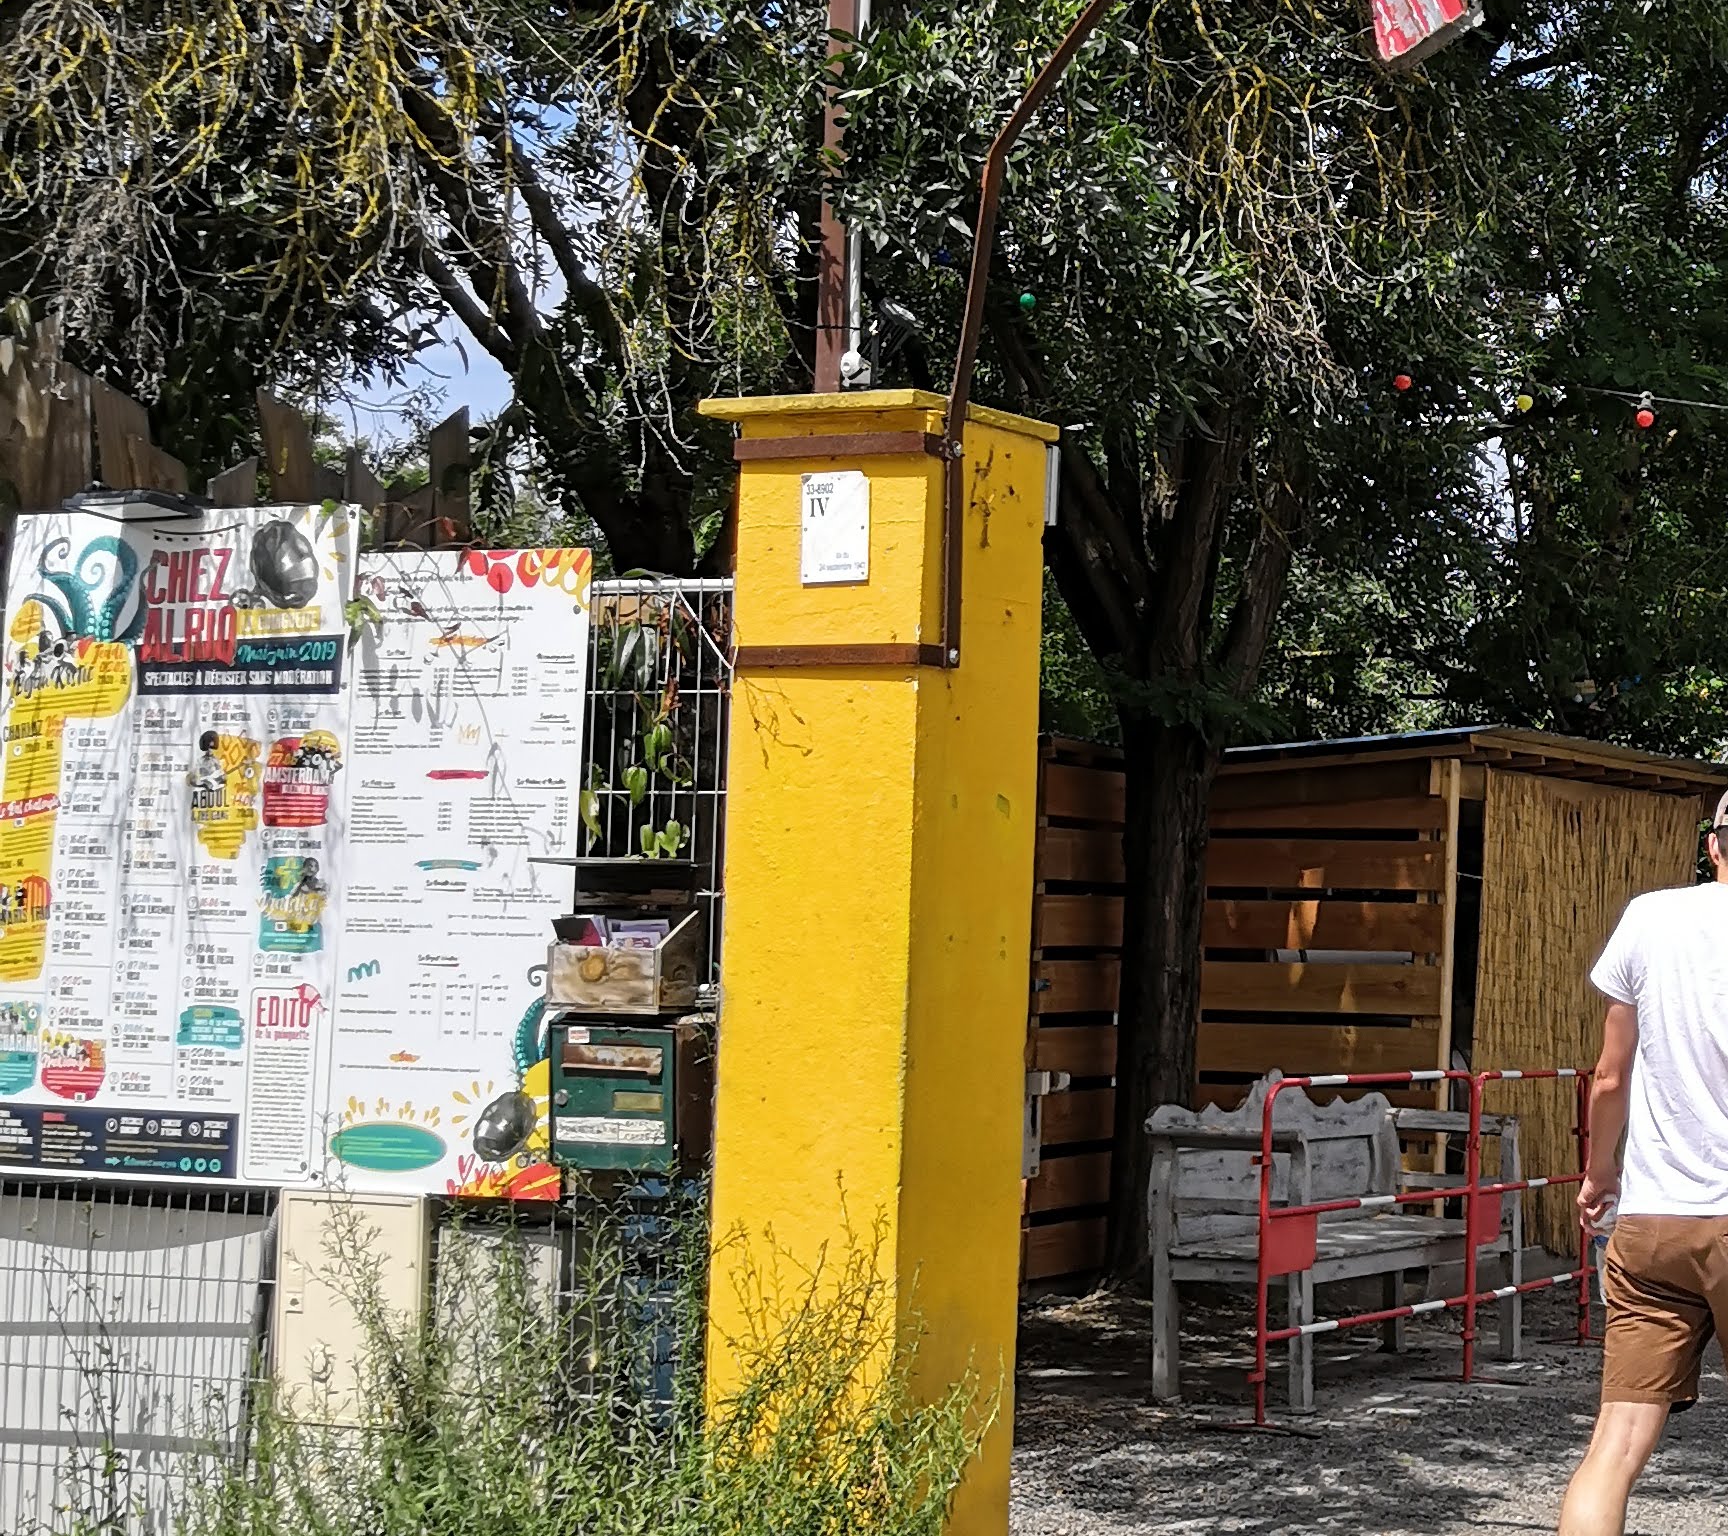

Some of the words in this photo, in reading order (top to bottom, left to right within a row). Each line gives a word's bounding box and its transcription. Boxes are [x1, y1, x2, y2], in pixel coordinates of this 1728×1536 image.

[810, 497, 830, 518] IV
[147, 547, 233, 605] CHEZ
[299, 640, 337, 662] 2019
[144, 669, 194, 686] SPECTACLES
[204, 667, 248, 686] DÉGUSTER
[249, 669, 273, 685] SANS
[274, 667, 334, 685] MODÉRATION
[264, 765, 330, 785] AMSTERDAM
[256, 996, 312, 1028] EDITO
